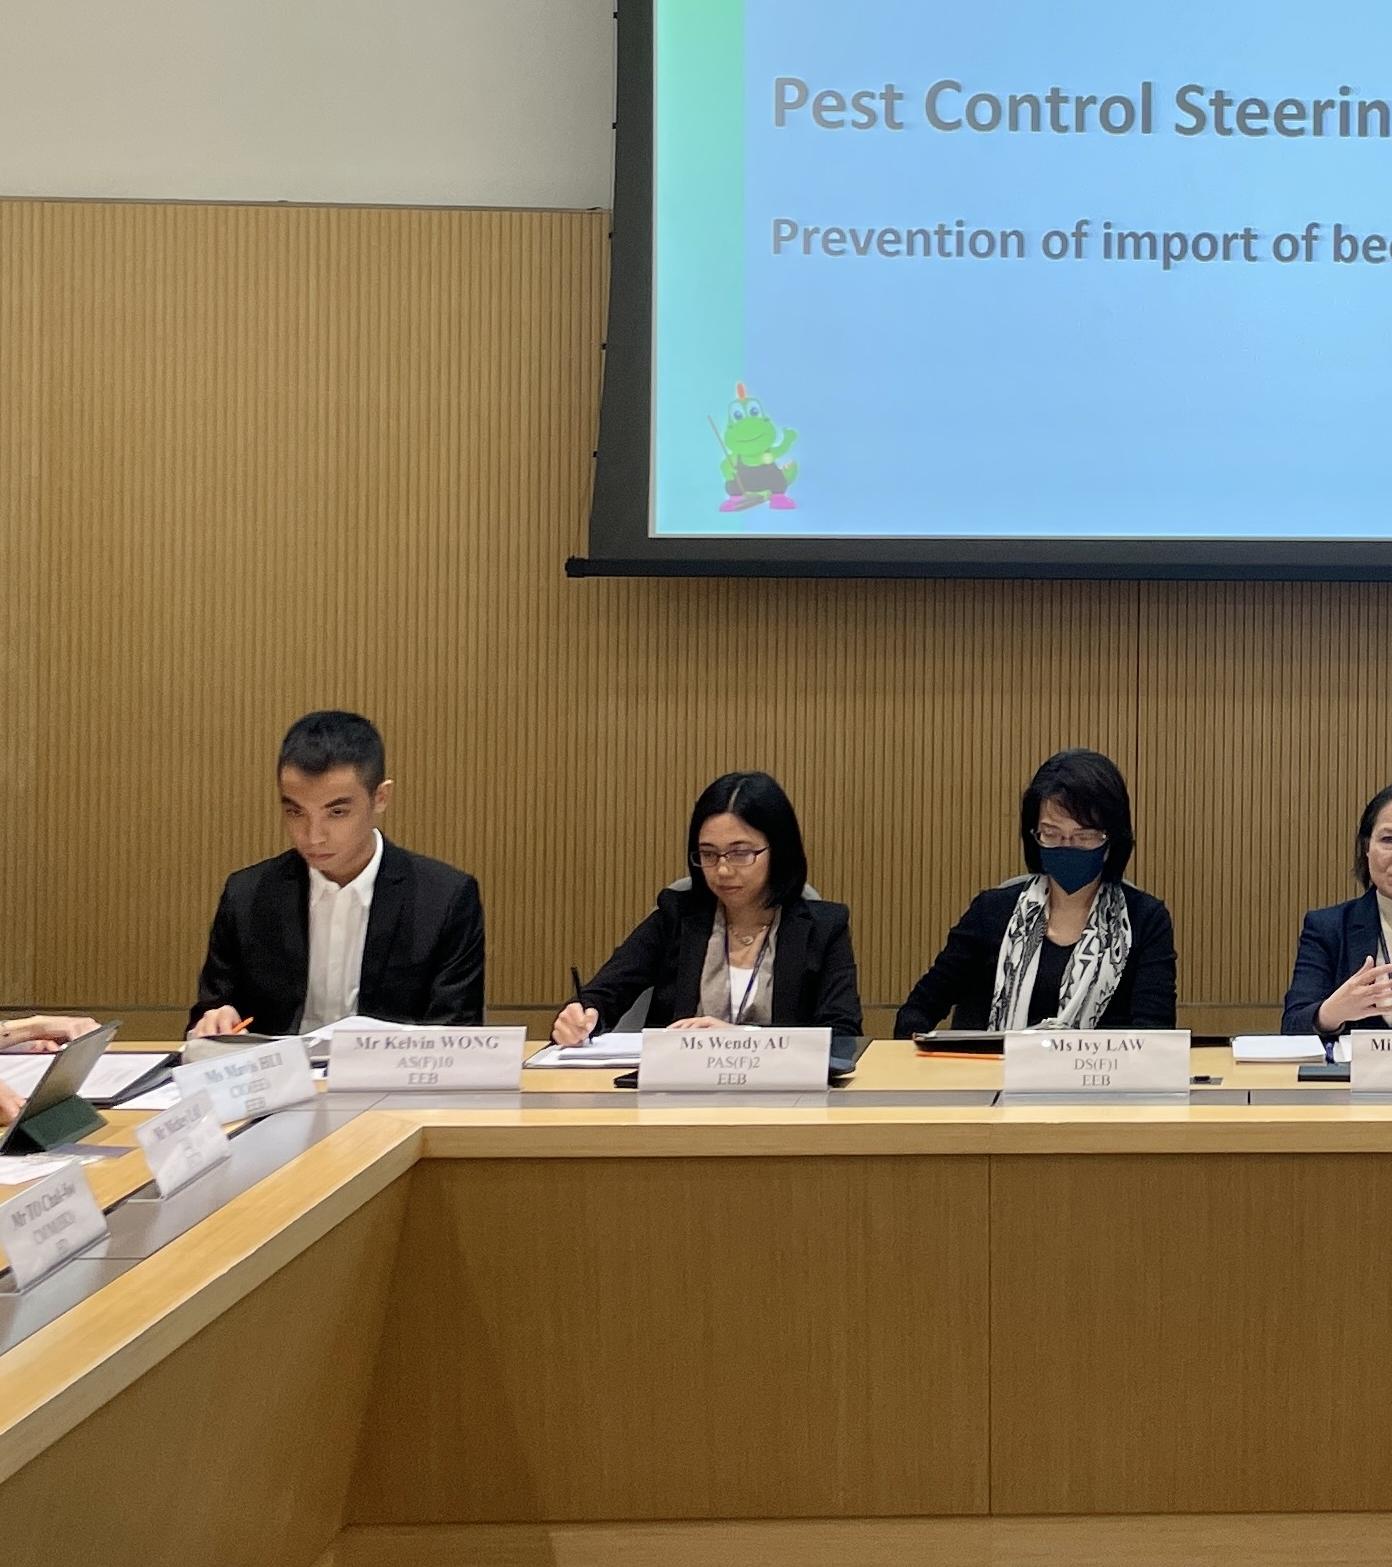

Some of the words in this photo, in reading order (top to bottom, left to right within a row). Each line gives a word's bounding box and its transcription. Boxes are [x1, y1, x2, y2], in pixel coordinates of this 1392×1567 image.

[775, 78, 905, 130] Pest
[926, 80, 1152, 134] Control
[774, 219, 1025, 258] Prevention
[1042, 219, 1091, 259] of
[1103, 221, 1259, 270] import
[1273, 222, 1320, 262] of
[354, 1037, 380, 1049] Mr
[384, 1036, 435, 1049] Kelvin
[441, 1035, 500, 1050] WONG
[681, 1037, 703, 1049] Ms
[709, 1037, 758, 1052] Wendy
[767, 1037, 791, 1050] AU
[1052, 1039, 1072, 1051] Ms
[1078, 1039, 1100, 1054] Ivy
[1107, 1039, 1146, 1052] LAW
[397, 1056, 454, 1070] AS(F)10
[707, 1056, 760, 1070] PAS(F)2
[1075, 1058, 1117, 1071] DS(F)1
[409, 1073, 438, 1085] EEB
[718, 1073, 747, 1085] EEB
[1083, 1075, 1110, 1087] EEB
